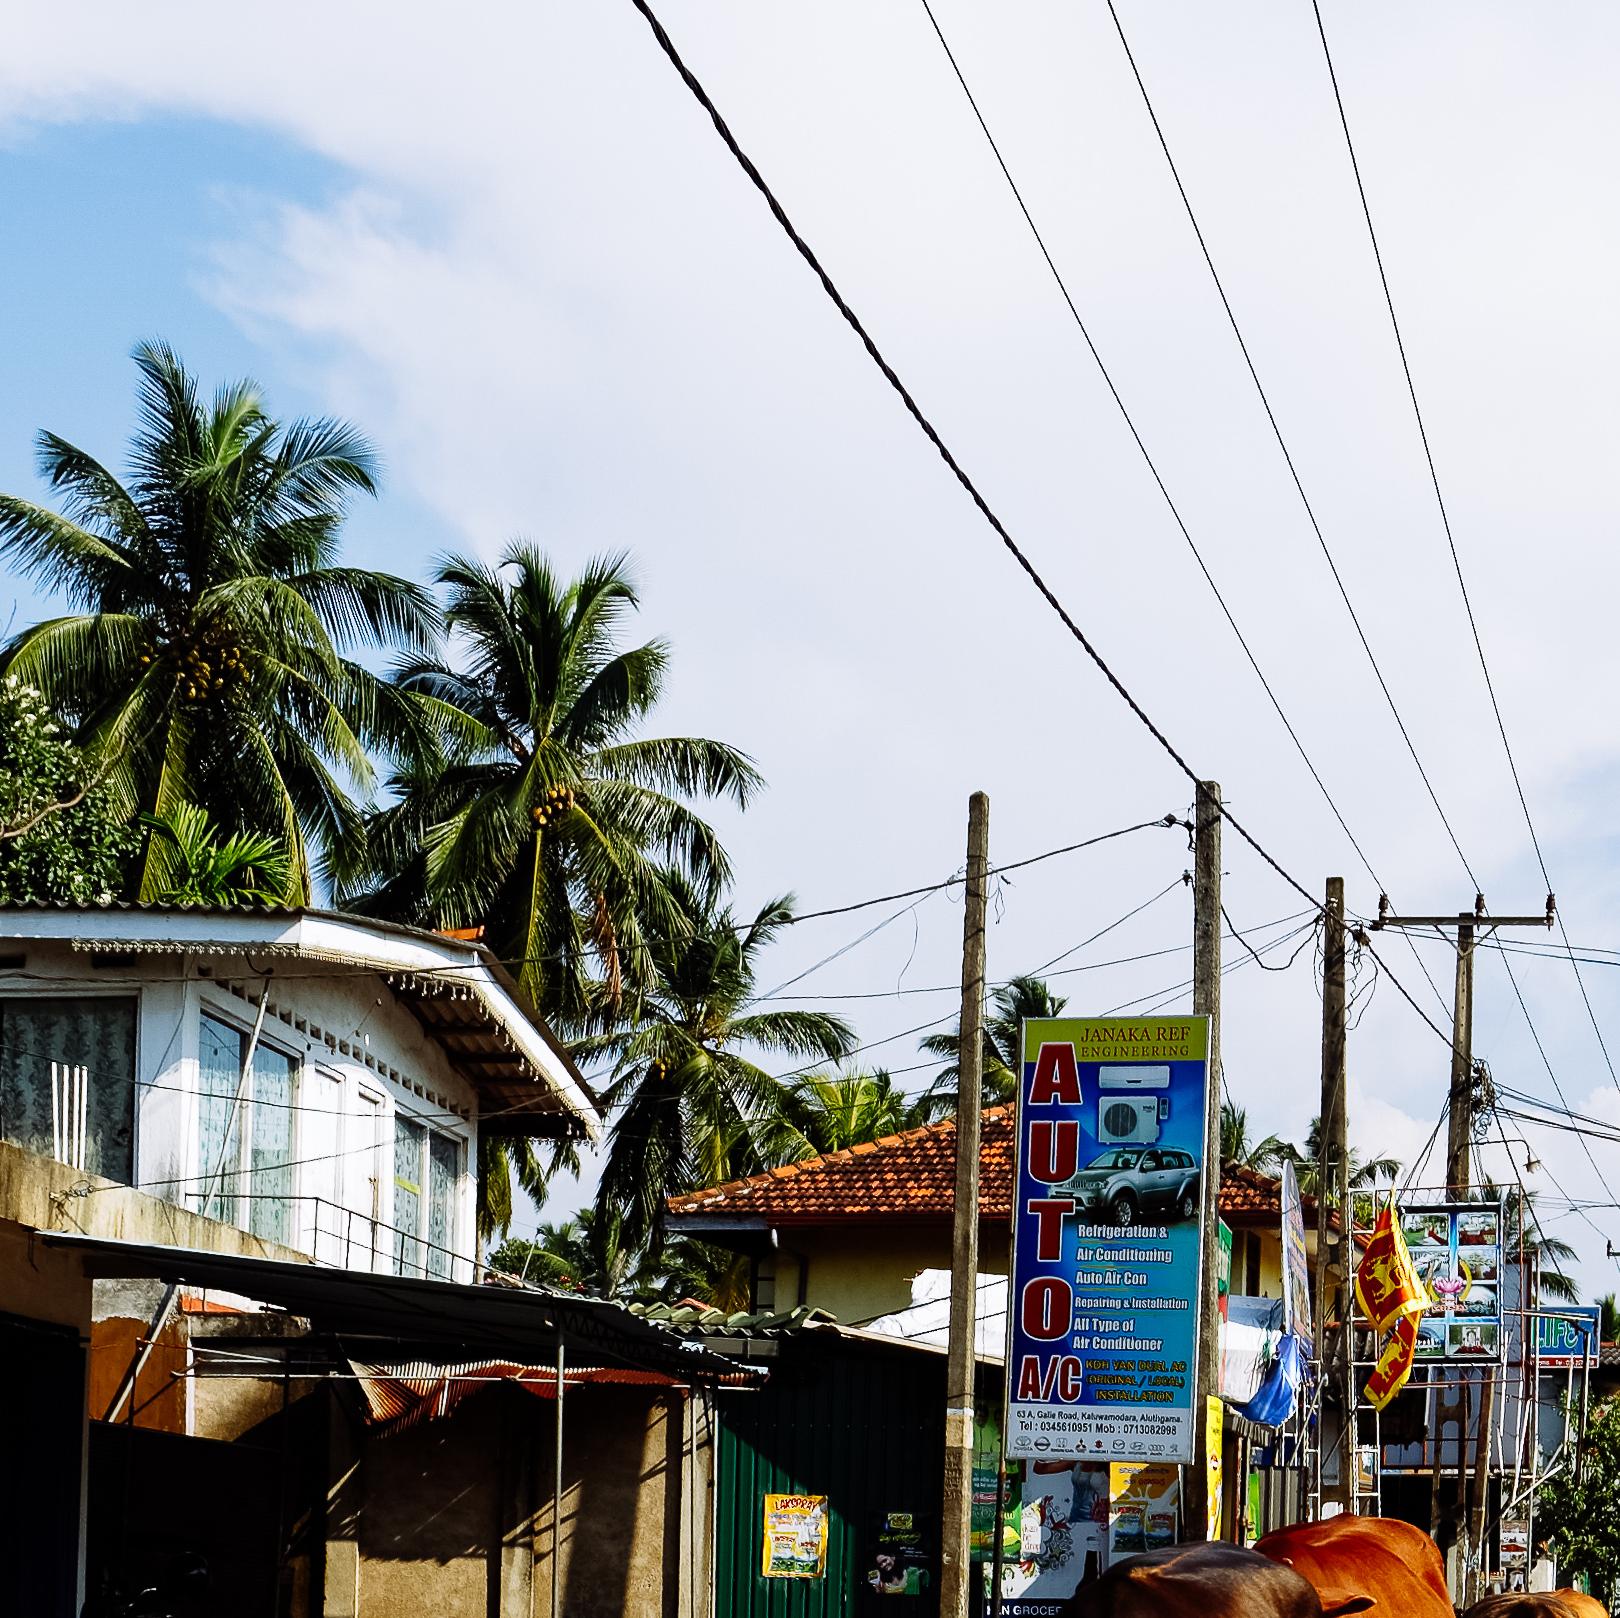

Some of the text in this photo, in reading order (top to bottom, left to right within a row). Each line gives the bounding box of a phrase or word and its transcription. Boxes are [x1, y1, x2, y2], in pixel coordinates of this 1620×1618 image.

[1081, 1026, 1191, 1042] JANAKA REF
[1081, 1045, 1189, 1057] ENGINEERING
[1022, 1041, 1083, 1342] AUTO
[1078, 1224, 1168, 1239] Refrigeration &
[1076, 1248, 1172, 1263] Air Conditioning
[1075, 1271, 1147, 1285] Auto Air Con
[1075, 1297, 1188, 1309] Repairing & Installation
[1073, 1318, 1135, 1332] All Type of
[1073, 1336, 1163, 1350] Air Conditioner
[1113, 1360, 1135, 1370] VAN
[1017, 1354, 1083, 1403] A/C
[1096, 1390, 1174, 1402] INSTALLATION
[1037, 1411, 1056, 1420] Galle
[1058, 1411, 1079, 1421] Road,
[1020, 1421, 1033, 1431] Tel
[1095, 1424, 1115, 1434] Mob
[1012, 1605, 1062, 1615] GROCE
